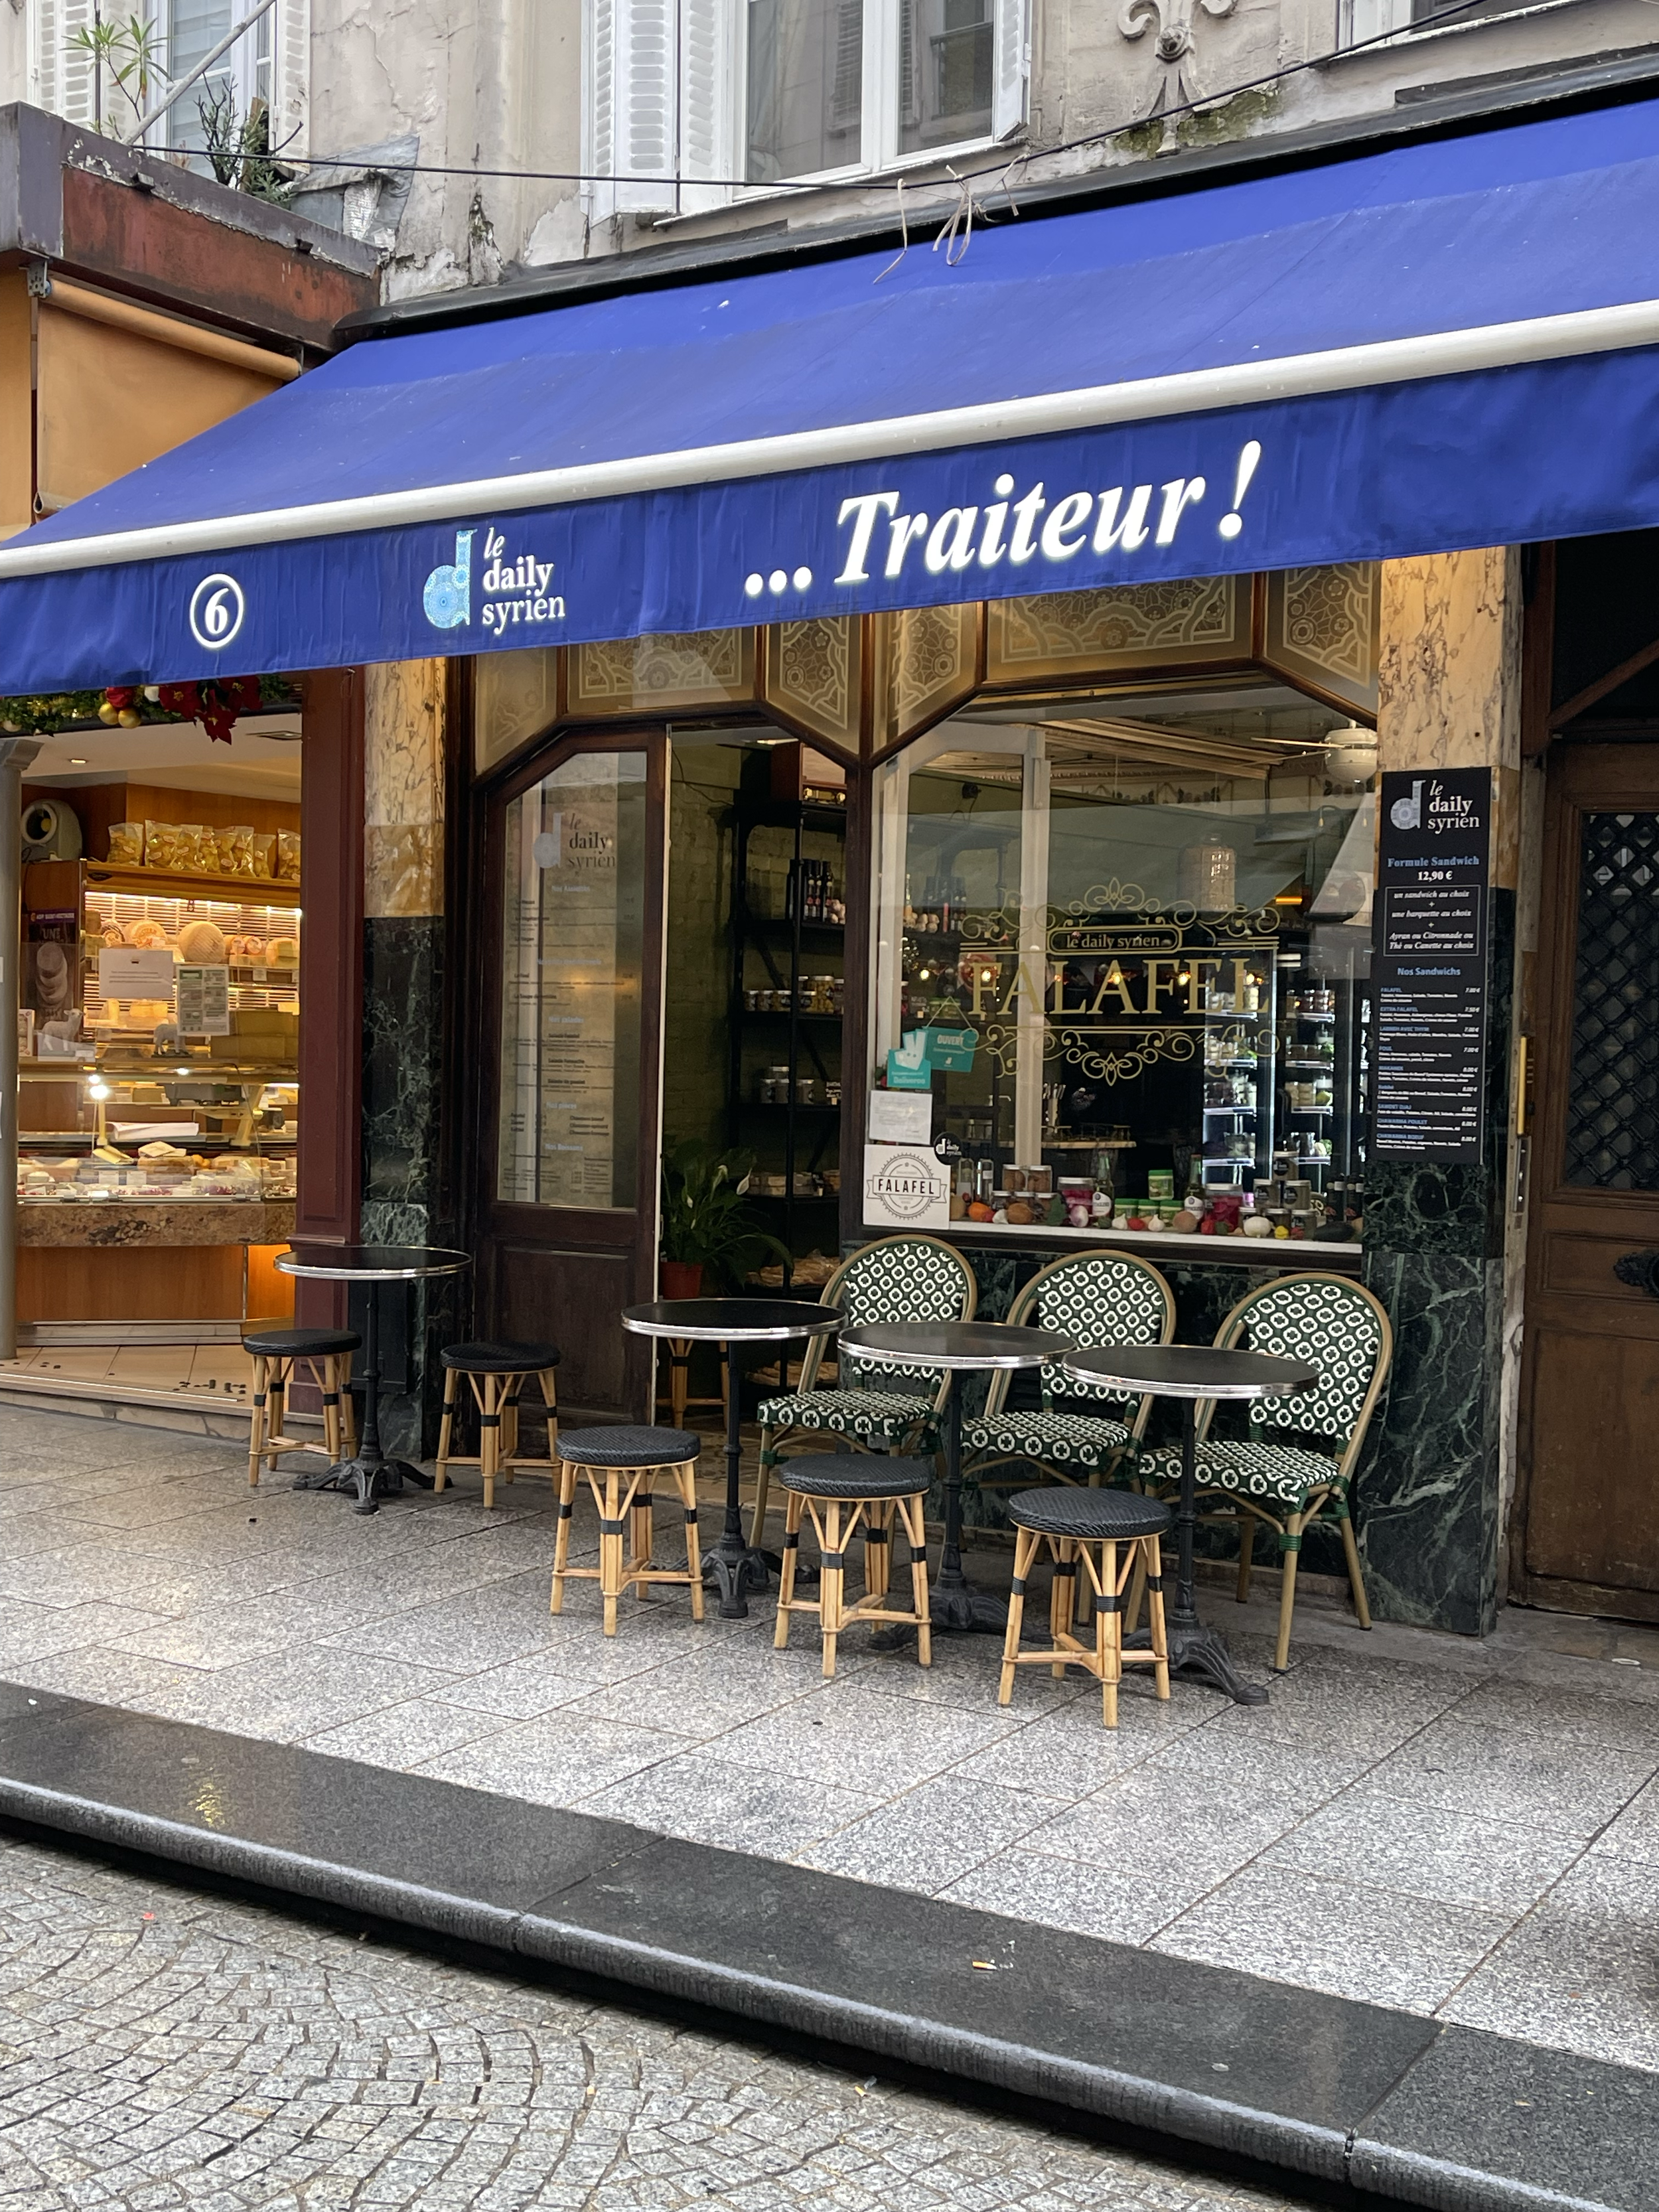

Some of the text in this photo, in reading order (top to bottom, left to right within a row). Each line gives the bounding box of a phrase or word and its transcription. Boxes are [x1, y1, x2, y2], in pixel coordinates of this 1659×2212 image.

[833, 473, 1205, 585] Traiteur
[1219, 439, 1262, 537] !
[484, 527, 505, 559] le
[482, 555, 554, 596] daily
[205, 588, 229, 634] 6
[482, 594, 565, 634] syrien
[1429, 780, 1443, 796] le
[1429, 796, 1473, 816] daily
[570, 812, 581, 830] le
[1427, 812, 1480, 834] syrien
[569, 832, 607, 854] daily
[568, 851, 615, 877] syrien
[1388, 855, 1479, 867] Formule Sandwich
[1418, 870, 1444, 881] 12,90
[1066, 933, 1160, 950] le daily syrien
[968, 957, 1269, 1016] FALAFEL
[937, 1034, 964, 1045] OUVERT
[879, 1179, 934, 1195] FALAFEL
